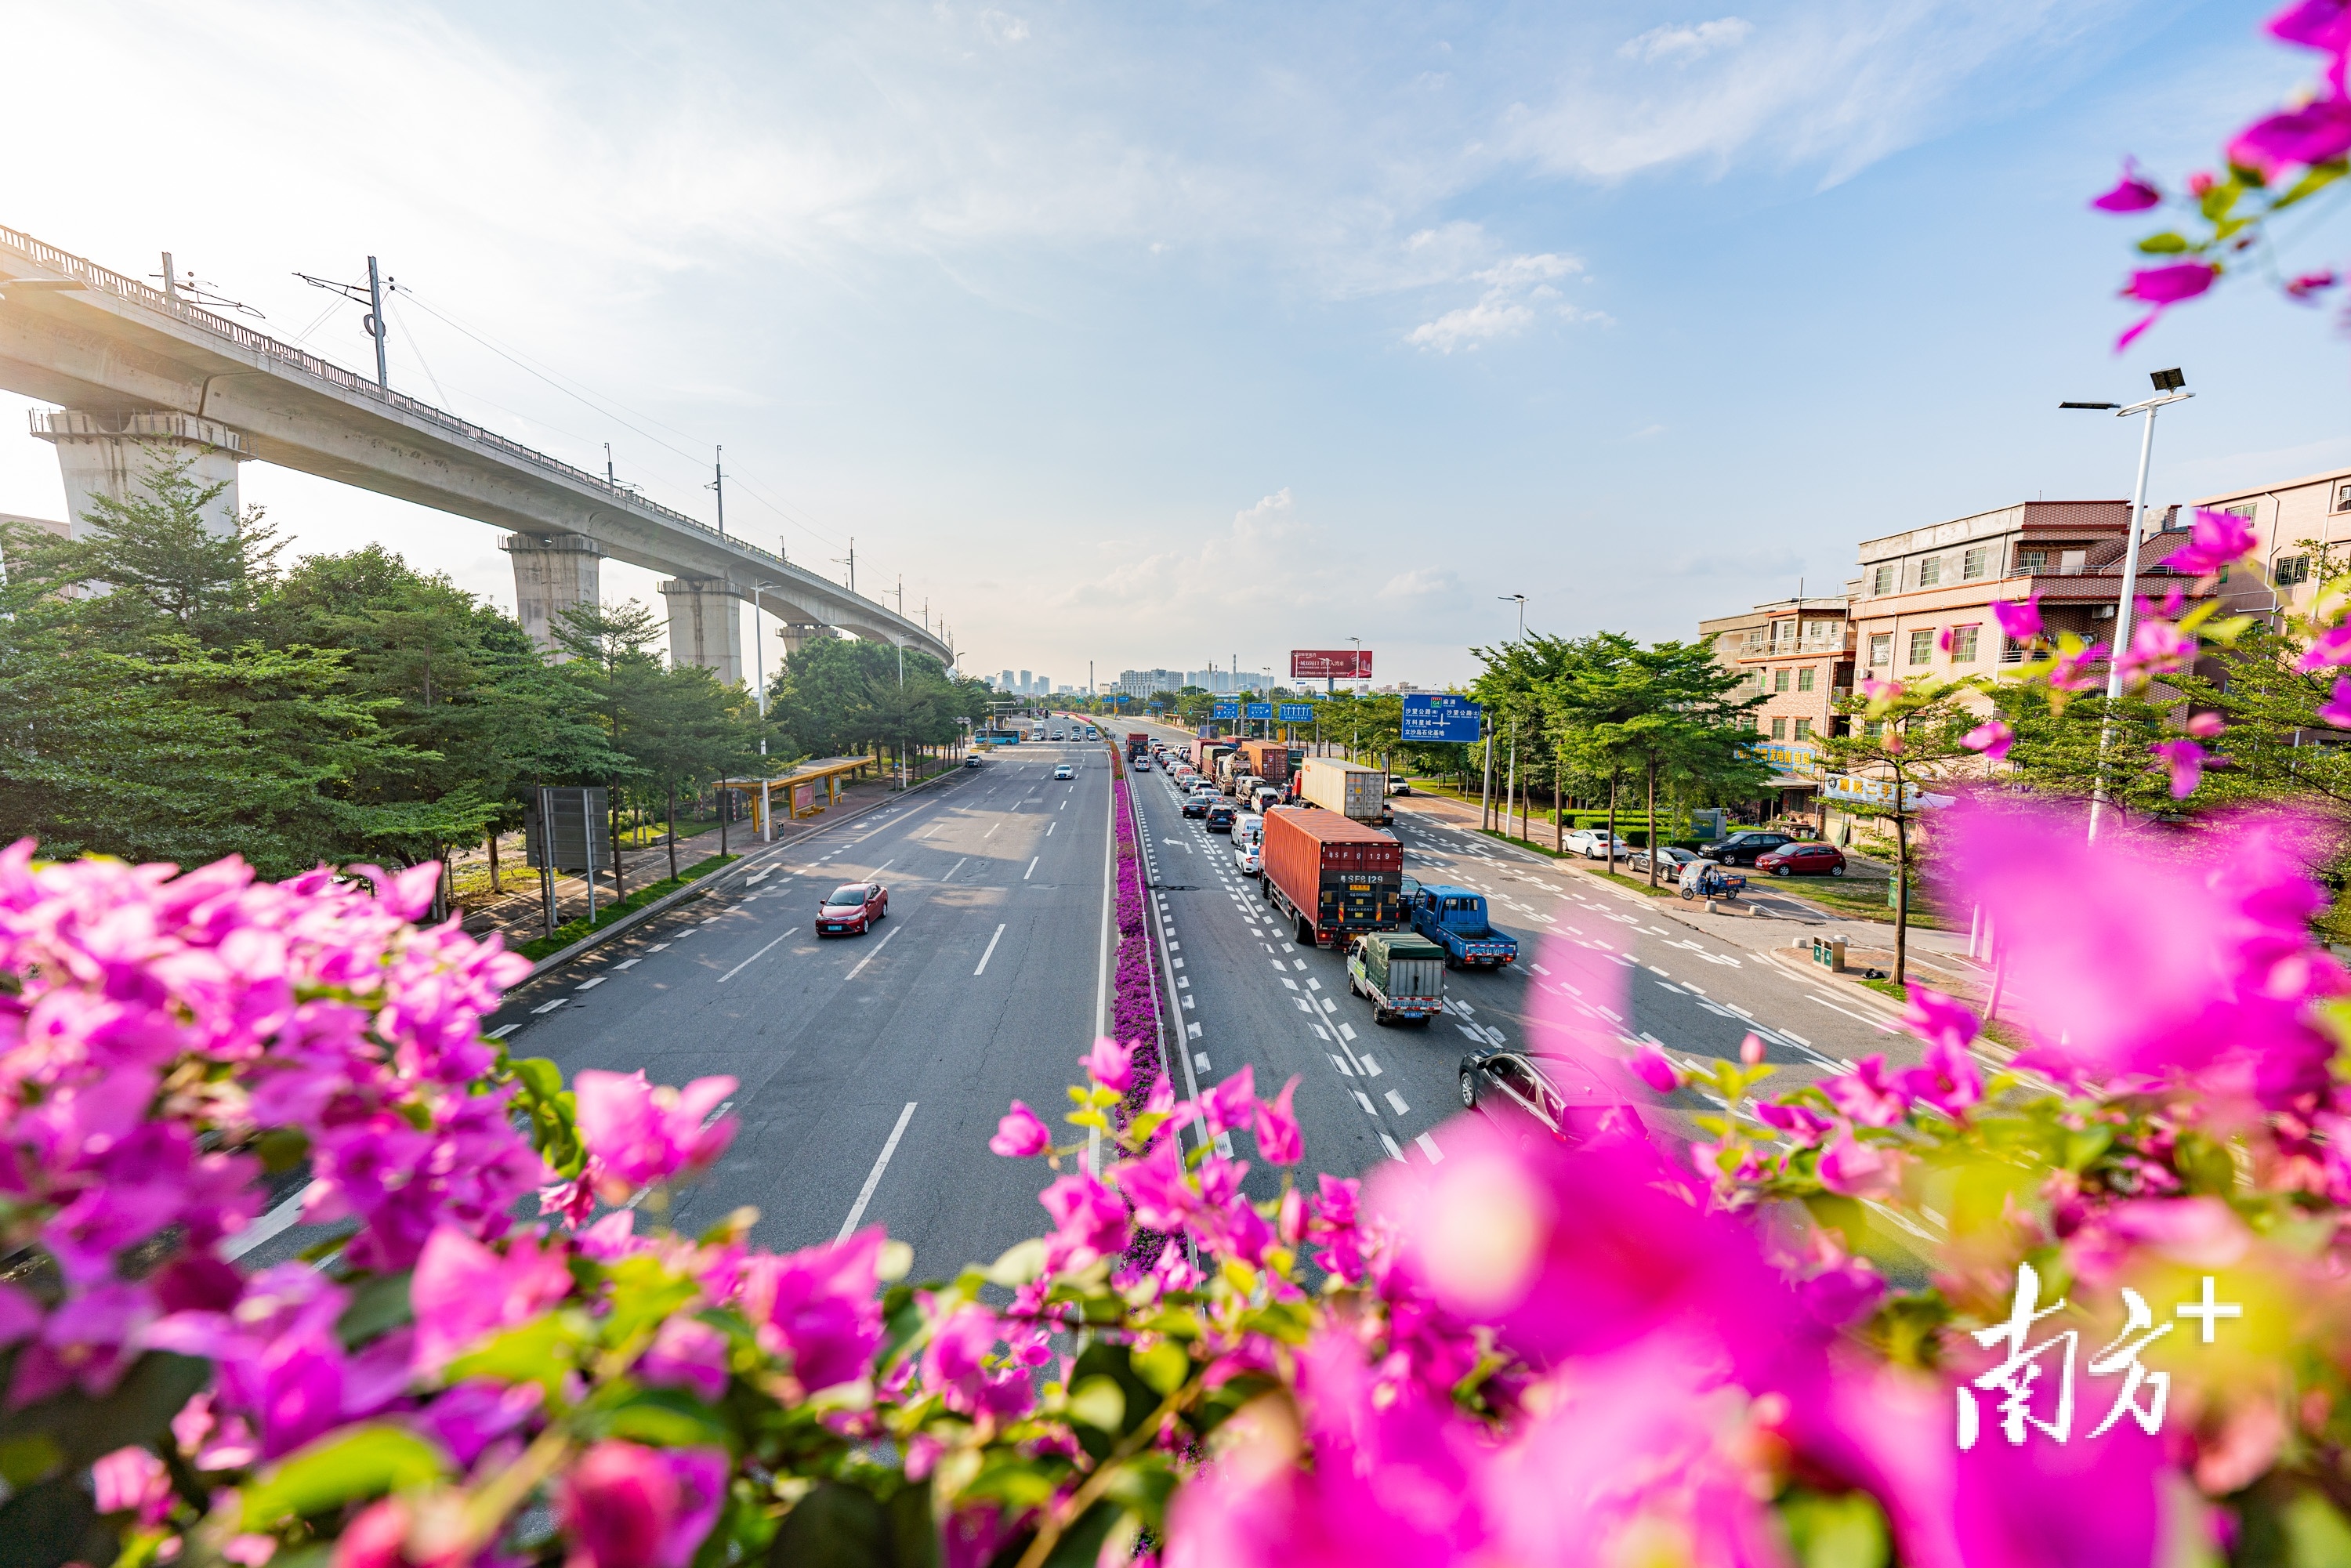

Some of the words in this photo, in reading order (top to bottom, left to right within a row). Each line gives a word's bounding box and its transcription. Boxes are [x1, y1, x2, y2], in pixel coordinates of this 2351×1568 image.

[1770, 748, 1792, 764] 发电机
[1794, 750, 1811, 766] 电路
